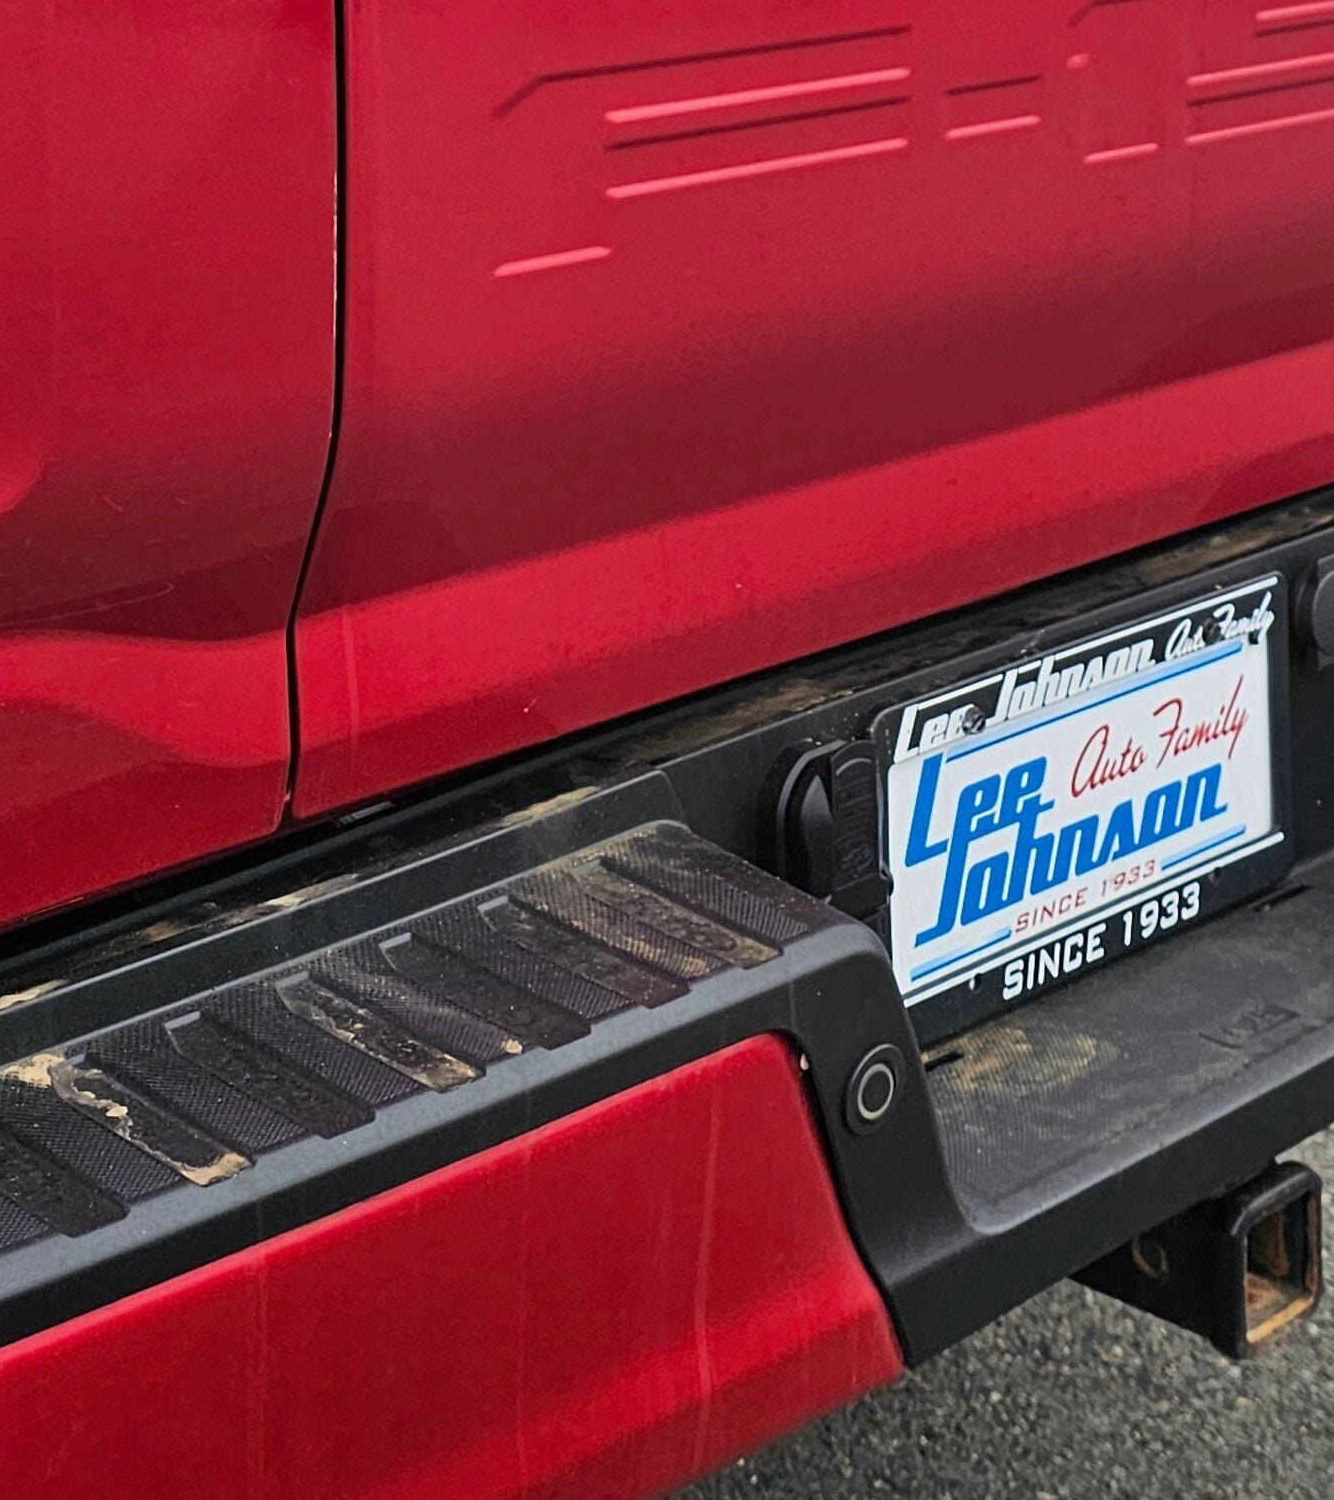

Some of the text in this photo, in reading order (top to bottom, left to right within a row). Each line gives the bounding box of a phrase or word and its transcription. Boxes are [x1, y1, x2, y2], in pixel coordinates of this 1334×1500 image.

[893, 591, 1275, 764] Lee Johnson Aut Family
[1071, 673, 1249, 798] Auto Family
[905, 752, 1051, 868] Lee
[914, 763, 1229, 948] Johnson
[1002, 881, 1201, 1001] SINCE 1933
[1015, 859, 1156, 933] SINCE 1933
